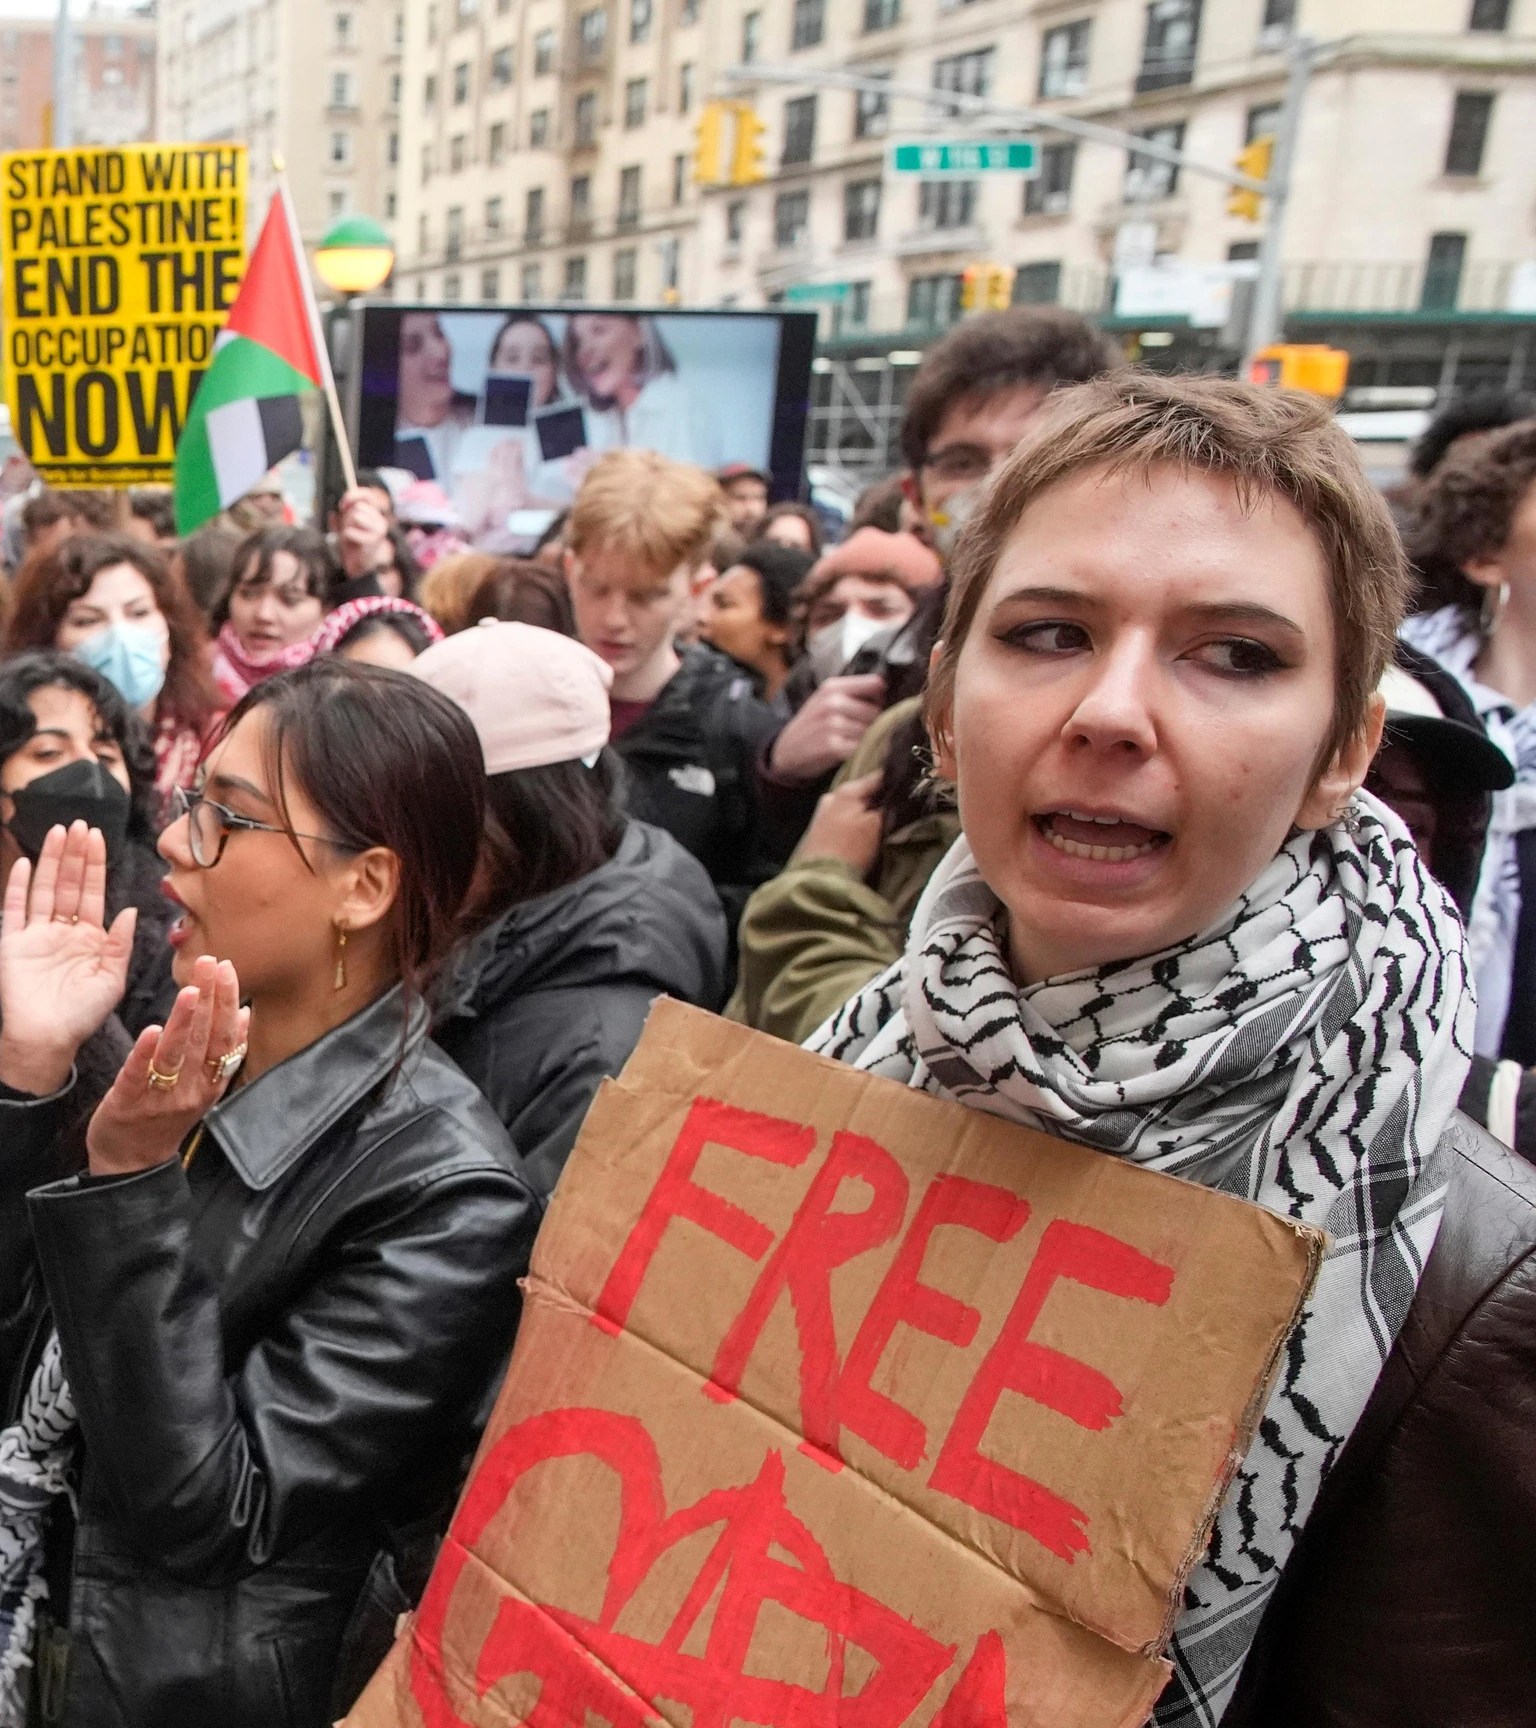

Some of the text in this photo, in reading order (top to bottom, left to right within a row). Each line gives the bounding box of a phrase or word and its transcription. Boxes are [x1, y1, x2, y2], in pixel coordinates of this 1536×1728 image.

[8, 150, 238, 200] STAND WITH
[10, 197, 239, 250] PALESTINE!
[15, 250, 241, 318] END THE
[17, 370, 206, 458] NOW
[589, 1095, 1176, 1565] FREE
